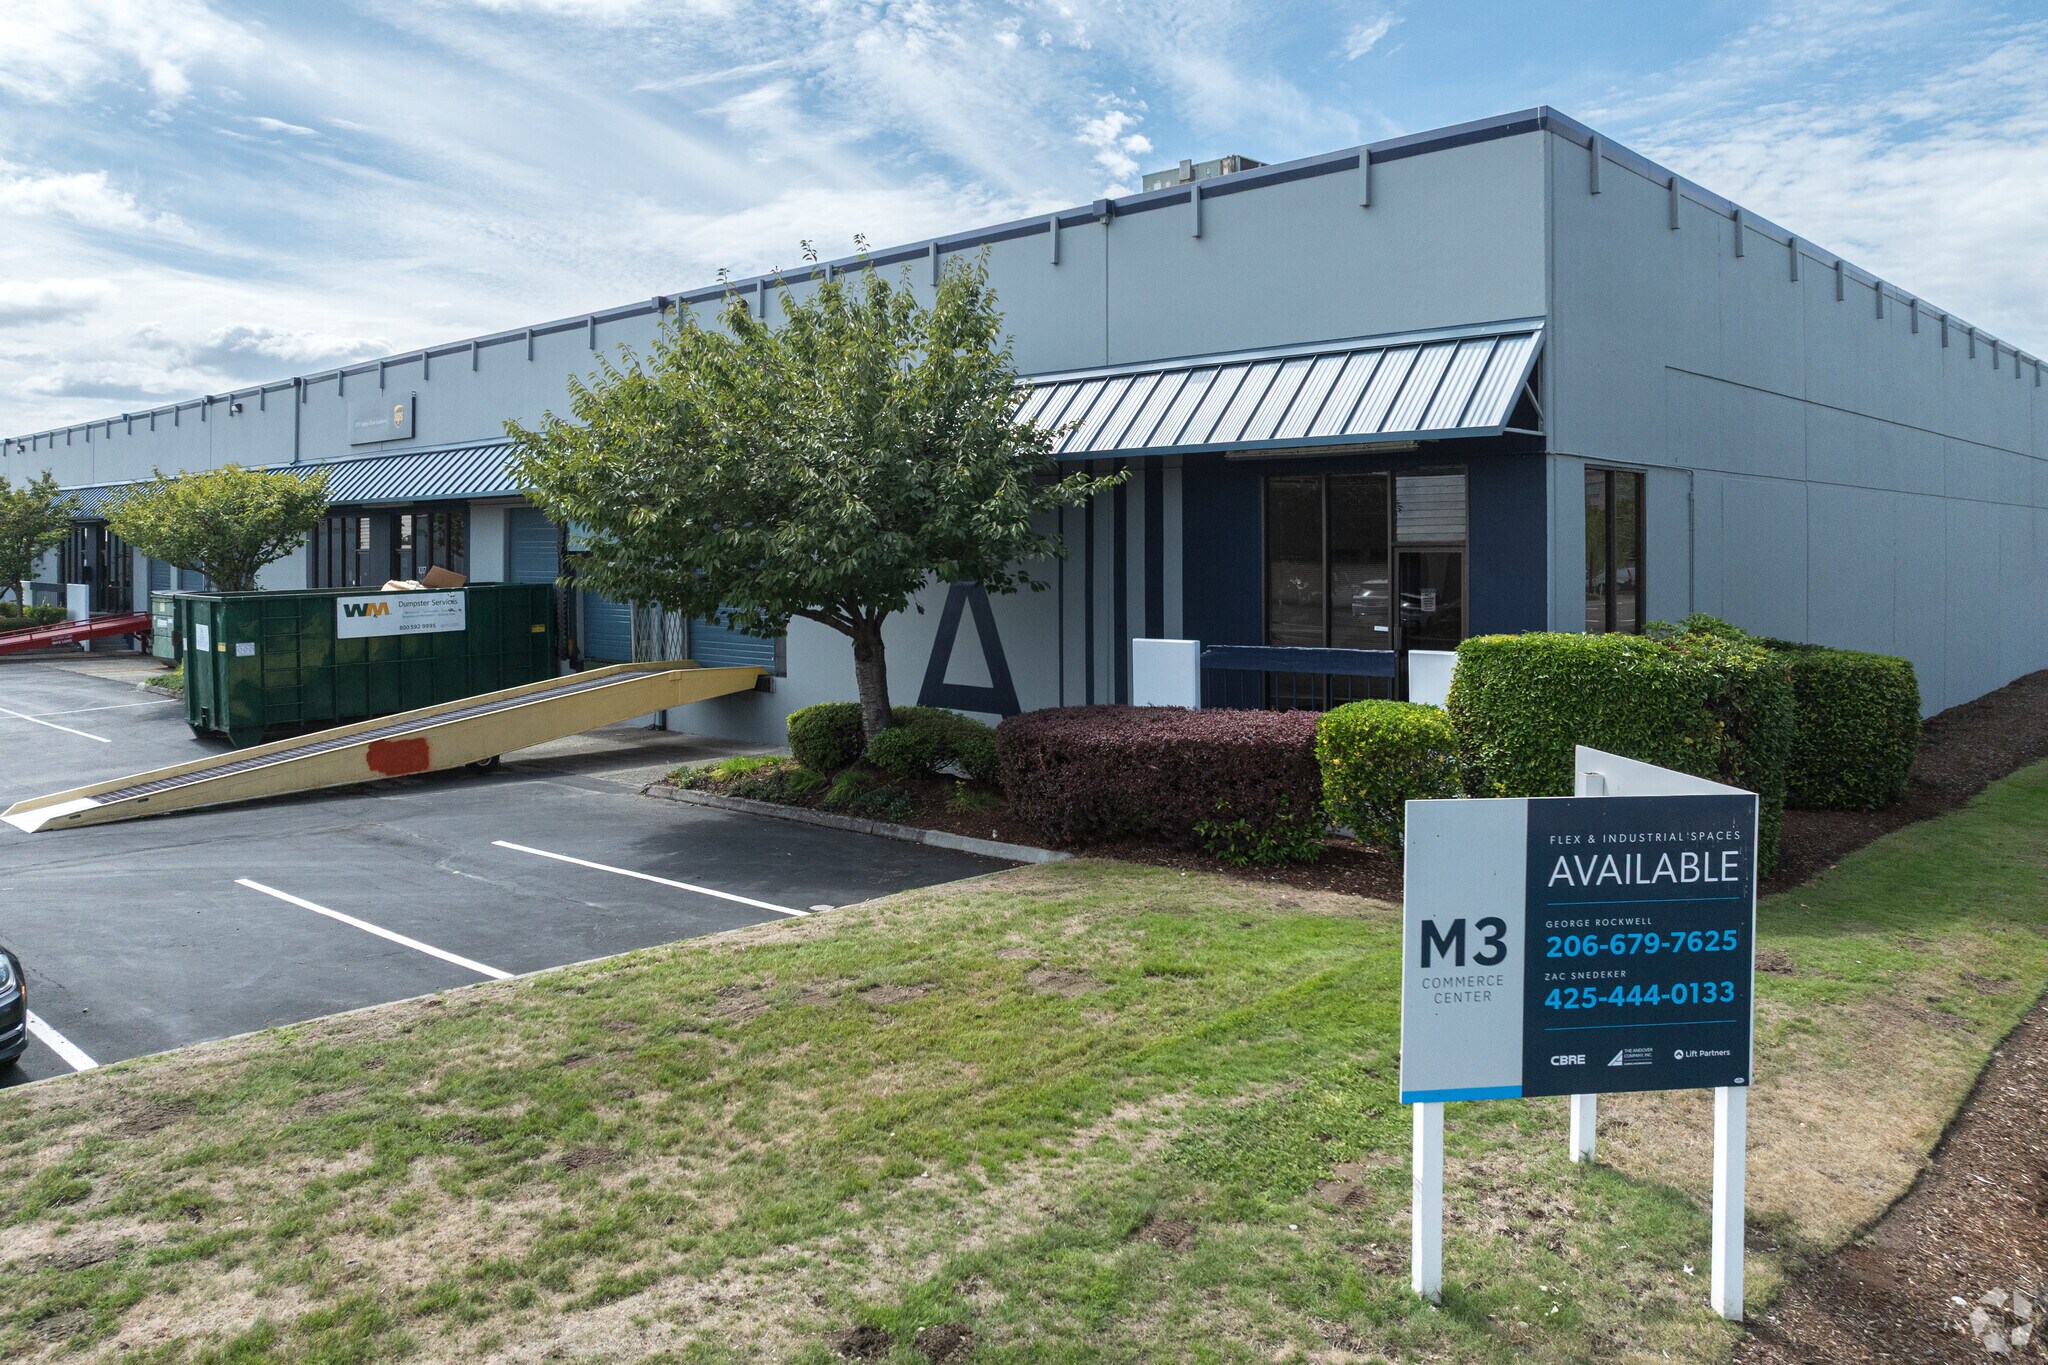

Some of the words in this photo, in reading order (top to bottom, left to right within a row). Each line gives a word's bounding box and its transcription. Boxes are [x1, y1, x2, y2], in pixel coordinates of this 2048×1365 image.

[343, 602, 390, 617] WM
[398, 600, 430, 608] Dumpster
[916, 580, 1022, 720] A
[1550, 834, 1581, 845] FLEX
[1588, 834, 1596, 844] &
[1603, 832, 1684, 843] INDUSTRIAL
[1690, 831, 1741, 841] SPACES
[1548, 851, 1739, 887] AVAILABLE
[1546, 919, 1590, 928] GEORGE
[1595, 917, 1652, 926] ROCKWELL
[1420, 916, 1508, 968] M3
[1546, 930, 1738, 958] 206-679-7625
[1422, 975, 1504, 989] COMMERCE
[1544, 972, 1566, 981] ZAC
[1571, 970, 1627, 980] SNEDEKER
[1434, 990, 1492, 1004] CENTER
[1544, 981, 1736, 1010] 425-444-0133
[1551, 1055, 1586, 1066] CBRE
[1685, 1050, 1698, 1058] Lift
[1699, 1049, 1731, 1057] Partners
